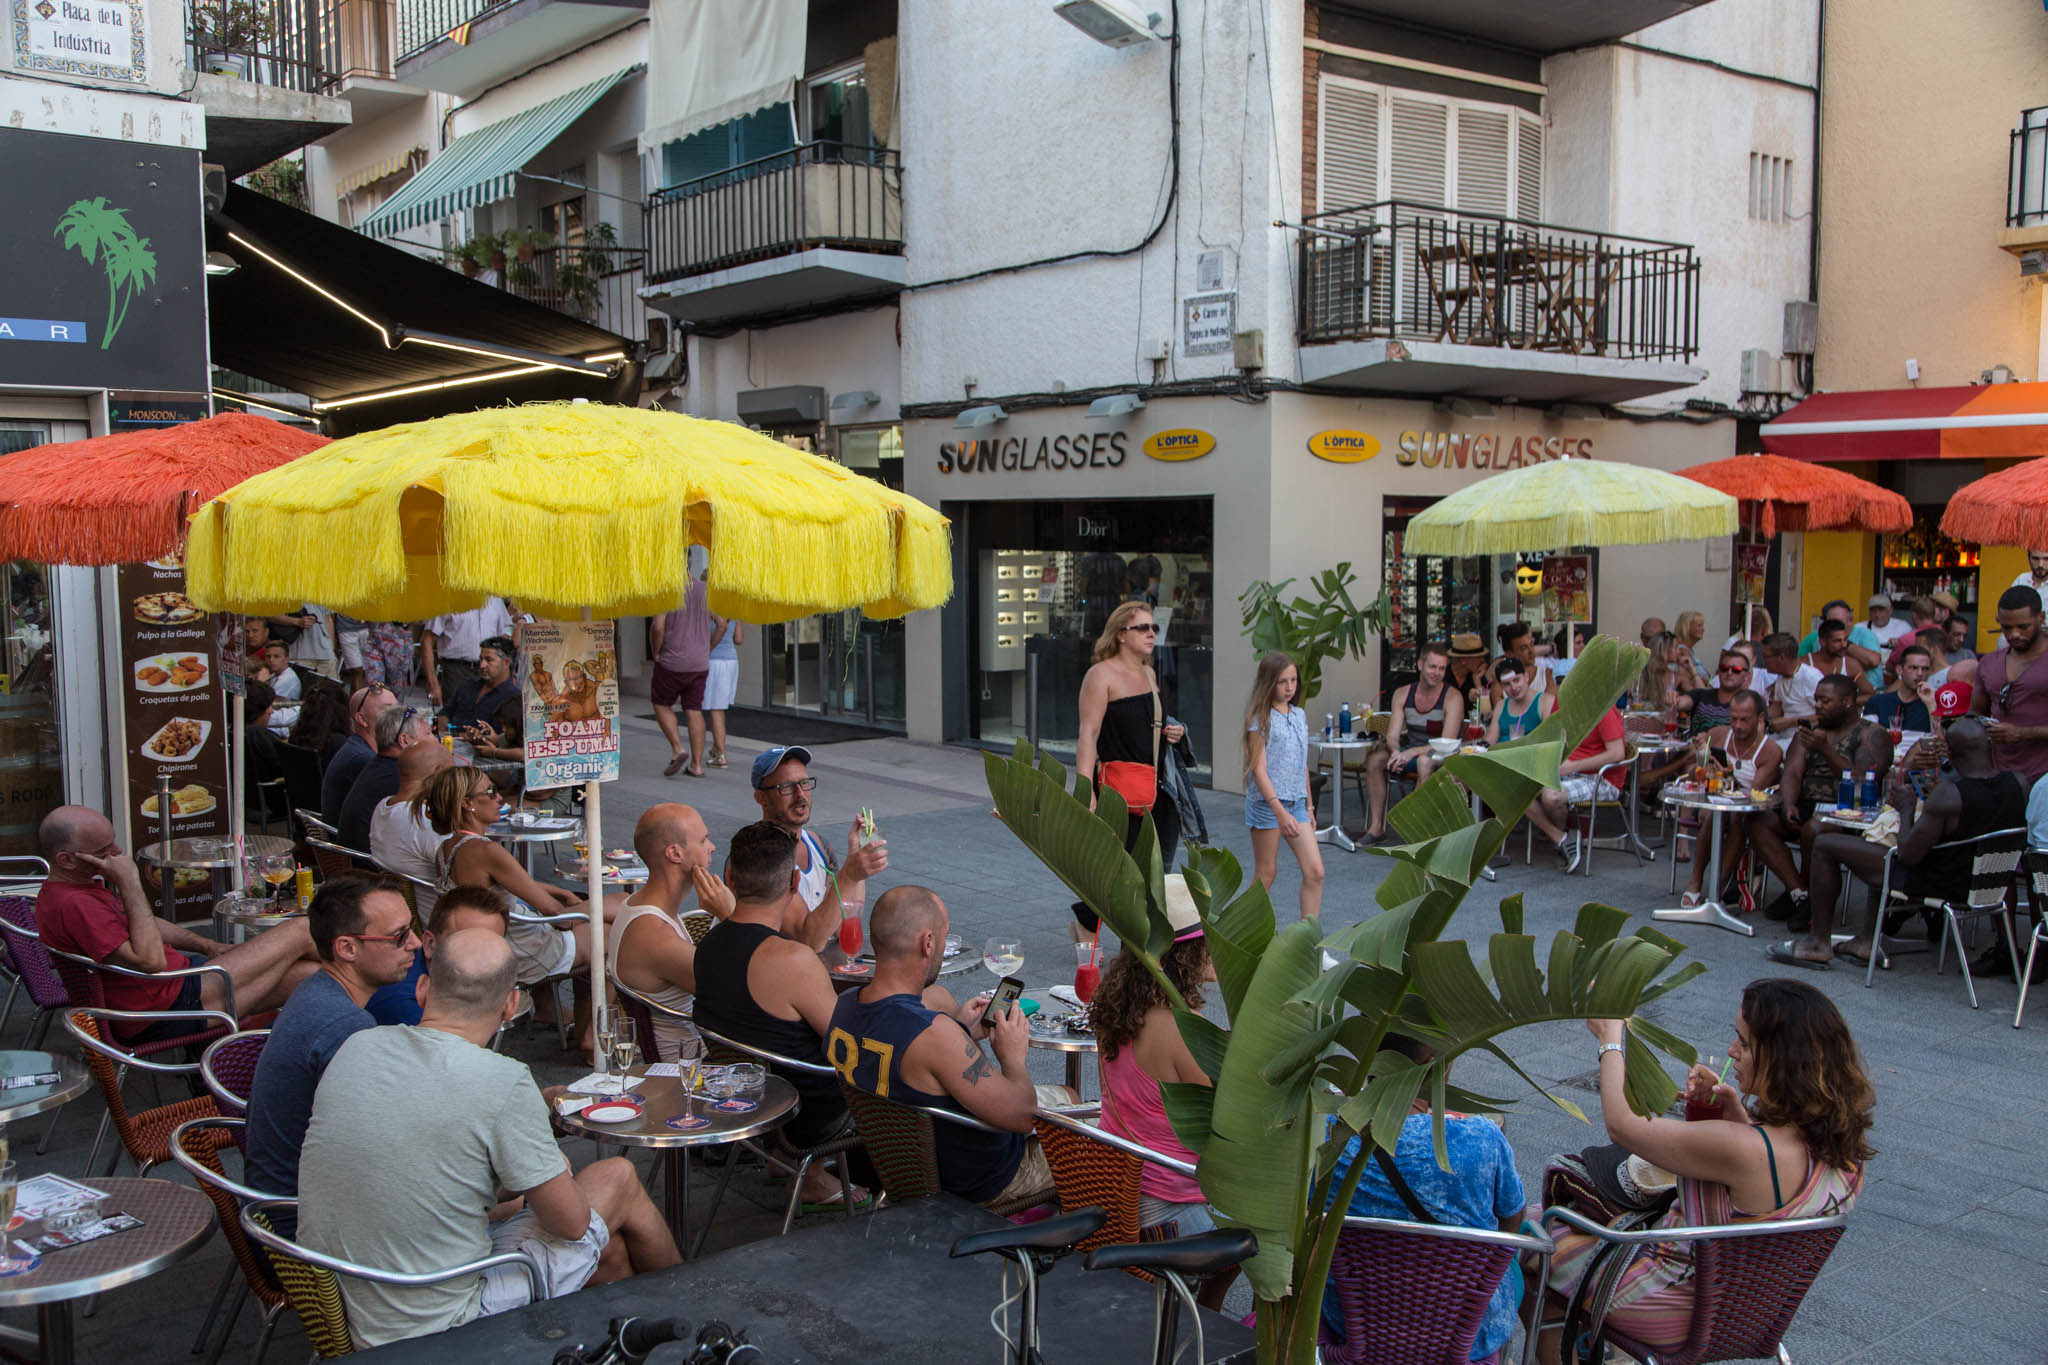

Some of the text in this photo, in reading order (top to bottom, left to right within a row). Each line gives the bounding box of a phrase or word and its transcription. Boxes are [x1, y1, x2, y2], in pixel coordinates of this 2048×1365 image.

[62, 1, 122, 26] Plaça de la
[53, 30, 111, 55] Indústria
[128, 409, 176, 420] MONSOON
[937, 431, 1128, 474] SUNGLASSES
[1396, 430, 1593, 470] SUNGLASSES
[1077, 516, 1108, 537] Dior
[153, 570, 182, 579] Nachos
[137, 631, 159, 640] Pulpo
[167, 630, 175, 639] la
[176, 629, 205, 640] Gallega
[139, 692, 210, 706] Croquetas de pollo
[544, 719, 605, 738] FOAM!
[157, 762, 198, 774] Chipirones
[545, 757, 604, 778] Organic
[176, 823, 185, 831] de
[186, 820, 215, 832] patatas
